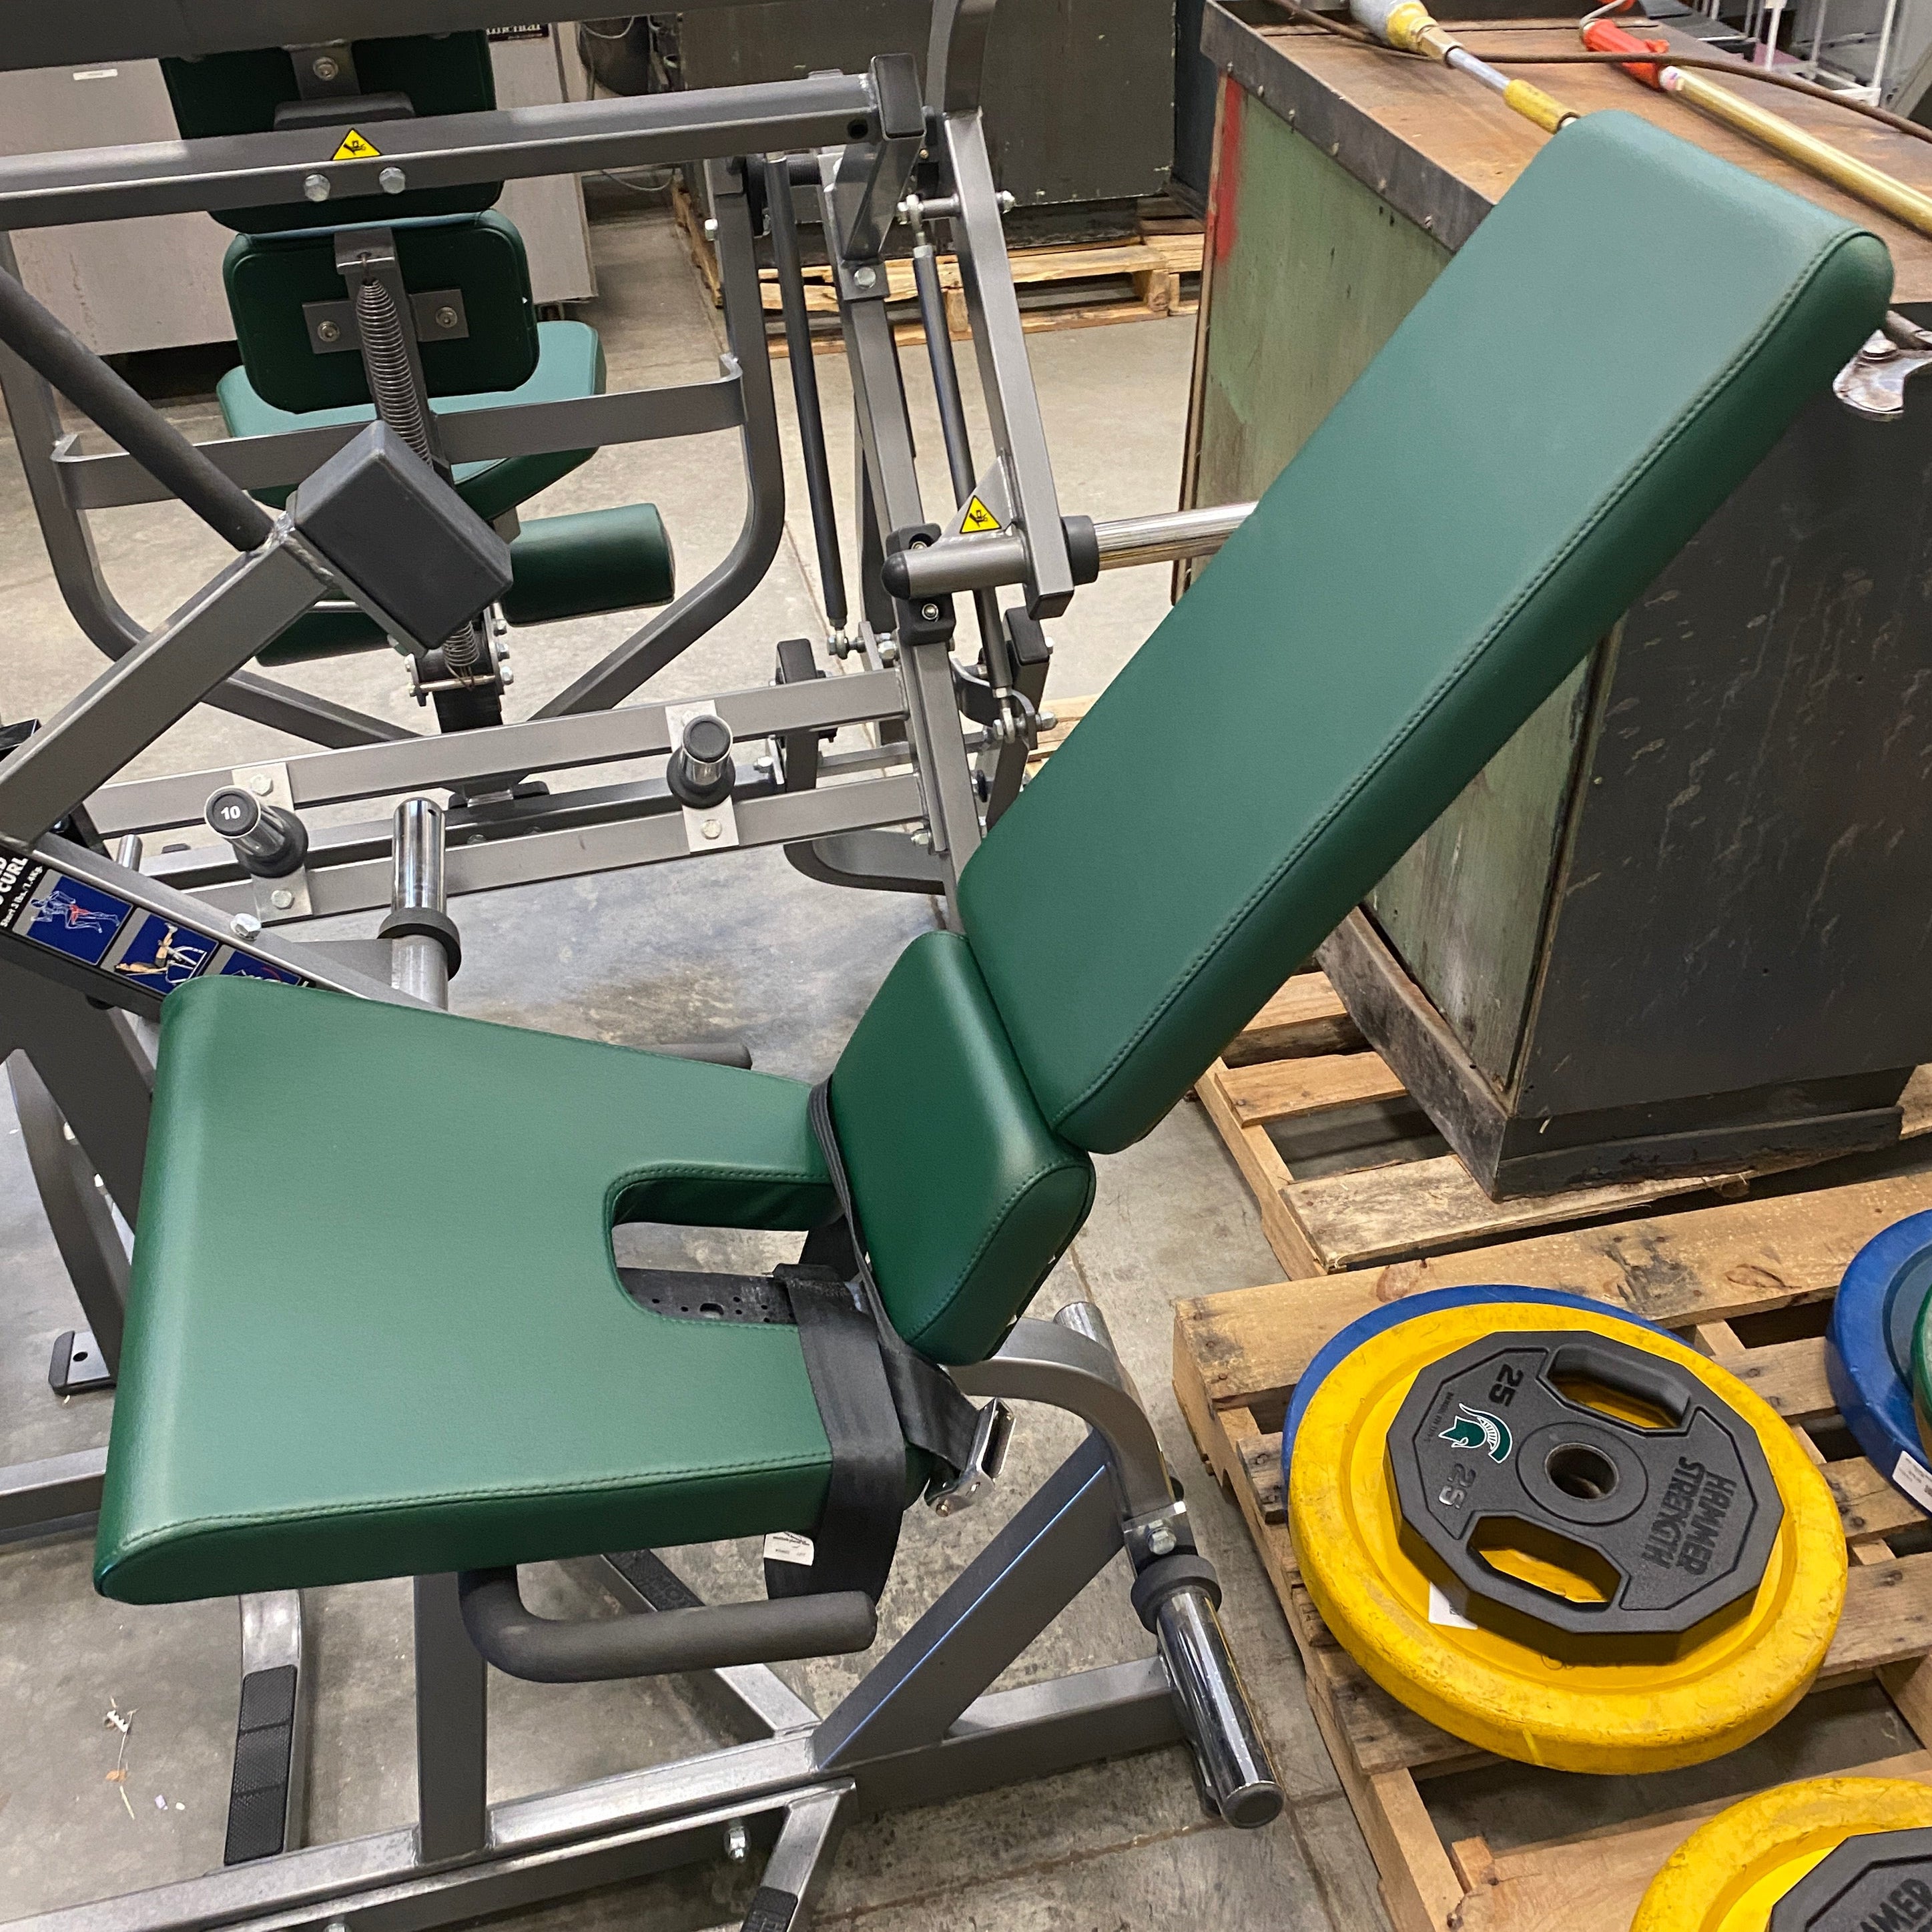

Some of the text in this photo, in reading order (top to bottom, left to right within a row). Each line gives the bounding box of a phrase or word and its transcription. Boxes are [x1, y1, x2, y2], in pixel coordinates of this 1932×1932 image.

[221, 806, 241, 820] 10
[0, 858, 29, 893] CURL
[1488, 1363, 1524, 1407] 25
[1438, 1463, 1476, 1510] 25
[1641, 1456, 1706, 1569] STRENGTH
[1675, 1471, 1737, 1575] HAMMER
